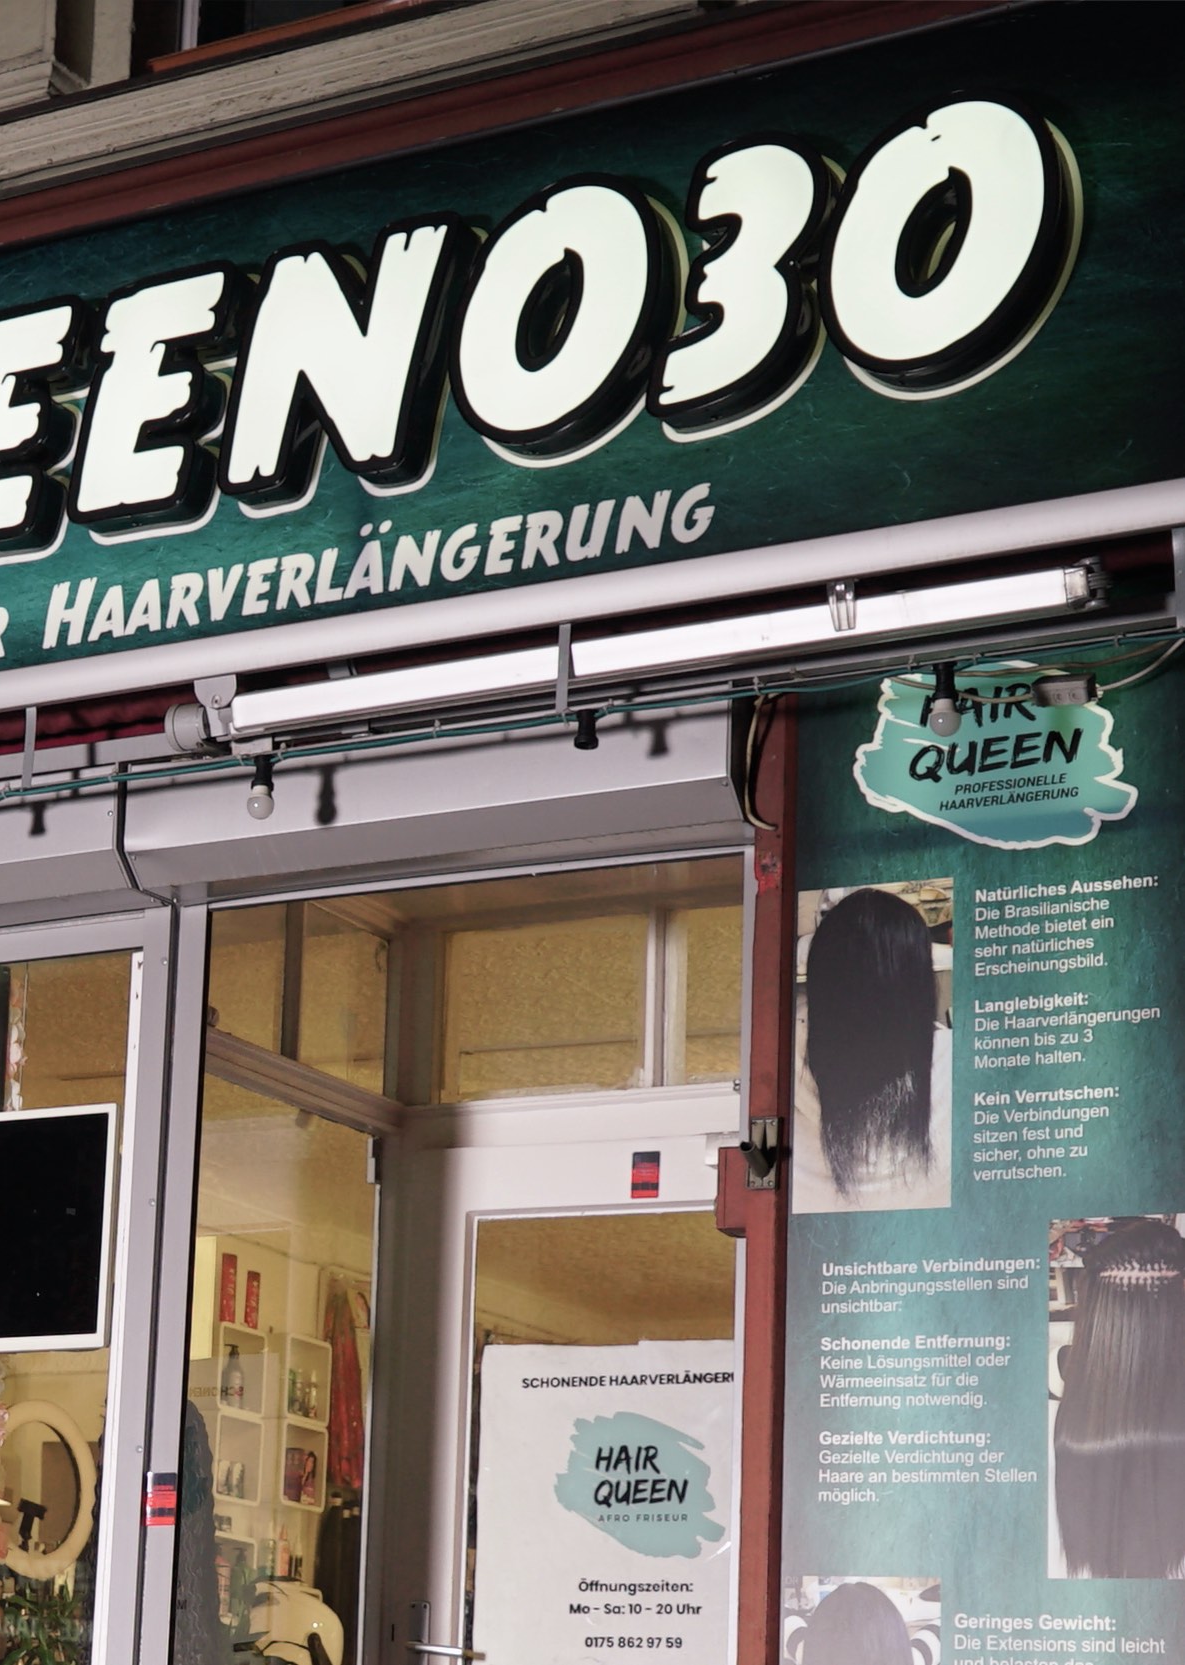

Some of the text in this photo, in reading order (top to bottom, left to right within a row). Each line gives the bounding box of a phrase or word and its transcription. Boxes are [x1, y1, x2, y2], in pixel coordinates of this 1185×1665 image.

[42, 482, 715, 650] HAARVERLÄNGERUNG
[909, 728, 1083, 782] QUEEN
[955, 773, 1066, 795] PROFESSIONELLE
[939, 786, 1079, 811] HAARVERLÄNGERUNG
[974, 875, 1158, 902] Natürliches Aussehen:
[975, 899, 1109, 922] Die Brasilianische
[974, 916, 1114, 939] Methode bietet ein
[974, 936, 1094, 958] sehr natürliches
[975, 954, 1108, 977] Erscheinungsbild.
[975, 993, 1088, 1015] Langlebigkeit:
[975, 1006, 1160, 1032] Die Haarverlängerungen
[974, 1029, 1093, 1050] können bis zu 3
[974, 1049, 1085, 1069] Monate halten.
[974, 1086, 1119, 1107] Kein Verrutschen:
[974, 1105, 1109, 1126] Die Verbindungen
[974, 1125, 1083, 1144] sitzen fest und
[974, 1145, 1088, 1164] sicher, ohne zu
[974, 1164, 1066, 1181] verrutschen.
[822, 1257, 1040, 1277] Unsichtbare Verbindungen:
[822, 1276, 1028, 1295] Die Anbringungsstellen sind
[821, 1335, 1011, 1351] Schonende Entfernung:
[820, 1353, 1010, 1371] Keine Lösungsmittel oder
[522, 1376, 606, 1388] SCHONENDE
[820, 1373, 978, 1389] Wärmeeinsatz für die
[820, 1392, 987, 1410] Entfernung notwendig.
[819, 1431, 991, 1446] Gezielte Verdichtung:
[595, 1445, 660, 1474] HAIR
[819, 1450, 1004, 1466] Gezielte Verdichtung der
[818, 1469, 1037, 1484] Haare an bestimmten Stellen
[594, 1479, 688, 1508] QUEEN
[818, 1489, 879, 1505] möglich.
[598, 1514, 688, 1522] AFRO FRISEUR
[578, 1578, 693, 1595] Öffnungszeiten:
[569, 1605, 590, 1614] Mo
[604, 1604, 626, 1615] Sa:
[629, 1605, 642, 1615] 10
[656, 1604, 672, 1615] 20
[676, 1604, 701, 1615] Uhr
[954, 1614, 1116, 1632] Geringes Gewicht:
[585, 1637, 682, 1648] 0175 862 97 59
[954, 1635, 1165, 1654] Die Extensions sind leicht
